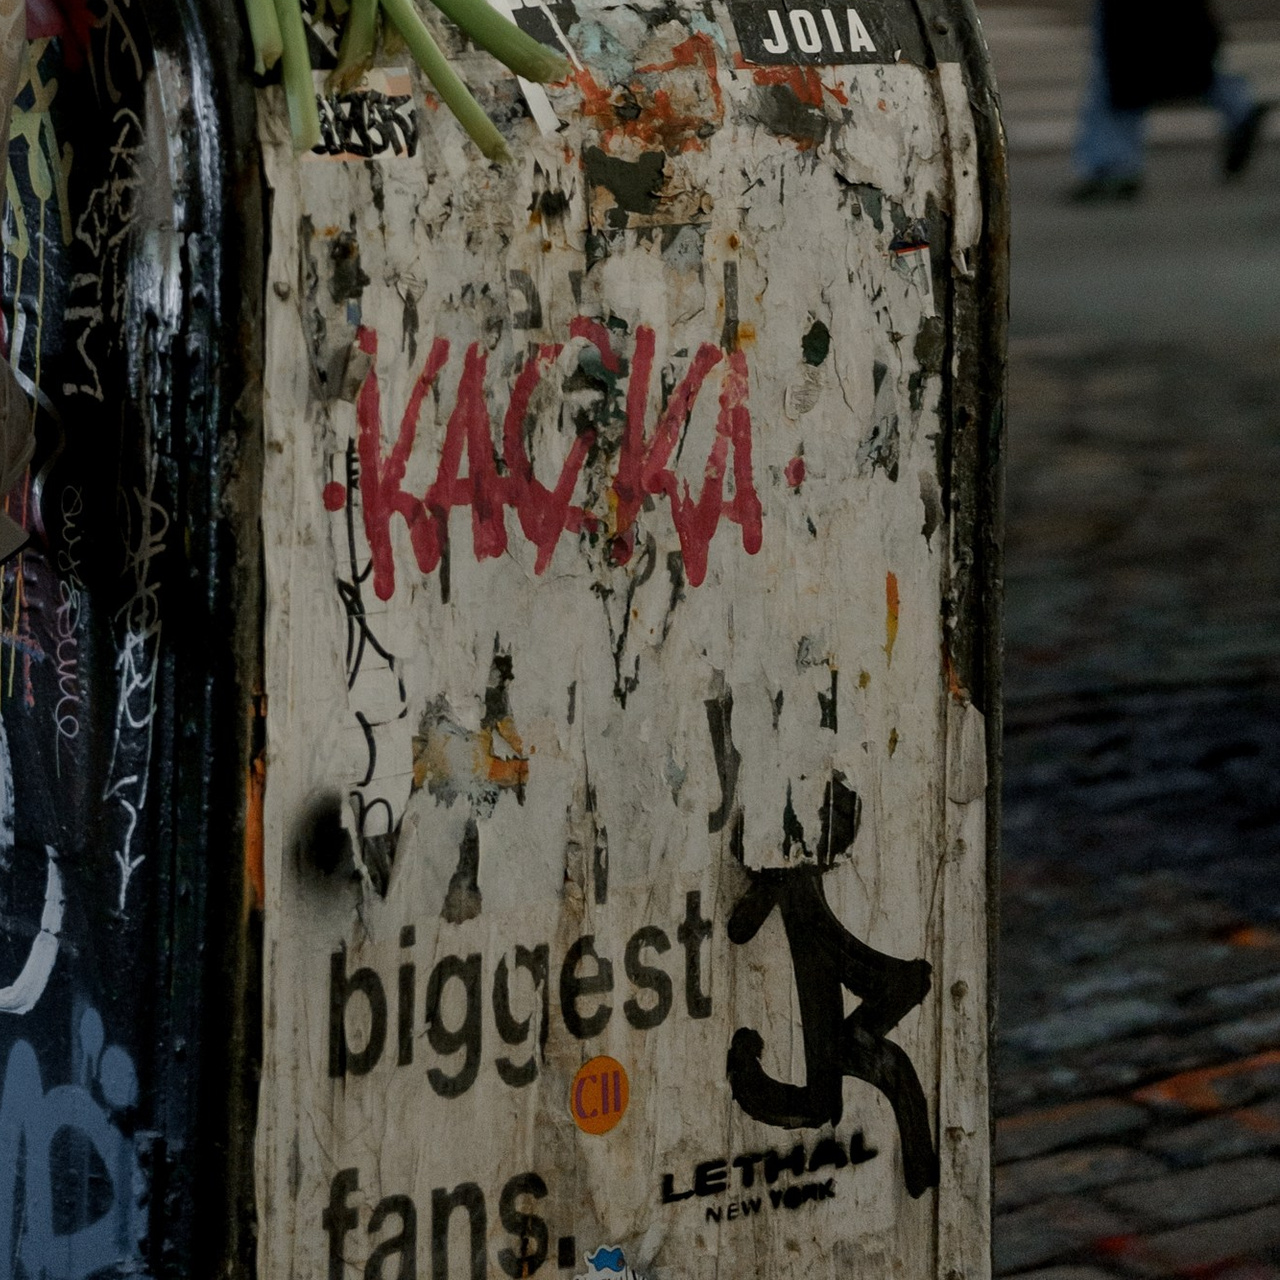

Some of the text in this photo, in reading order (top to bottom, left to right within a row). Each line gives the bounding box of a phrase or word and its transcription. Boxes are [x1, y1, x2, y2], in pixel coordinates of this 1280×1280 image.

[763, 7, 877, 54] JOIA
[328, 890, 713, 1100] biggest
[661, 1131, 879, 1204] LETHAL
[705, 1178, 837, 1223] NEW YORK
[321, 1167, 576, 1280] fans.
